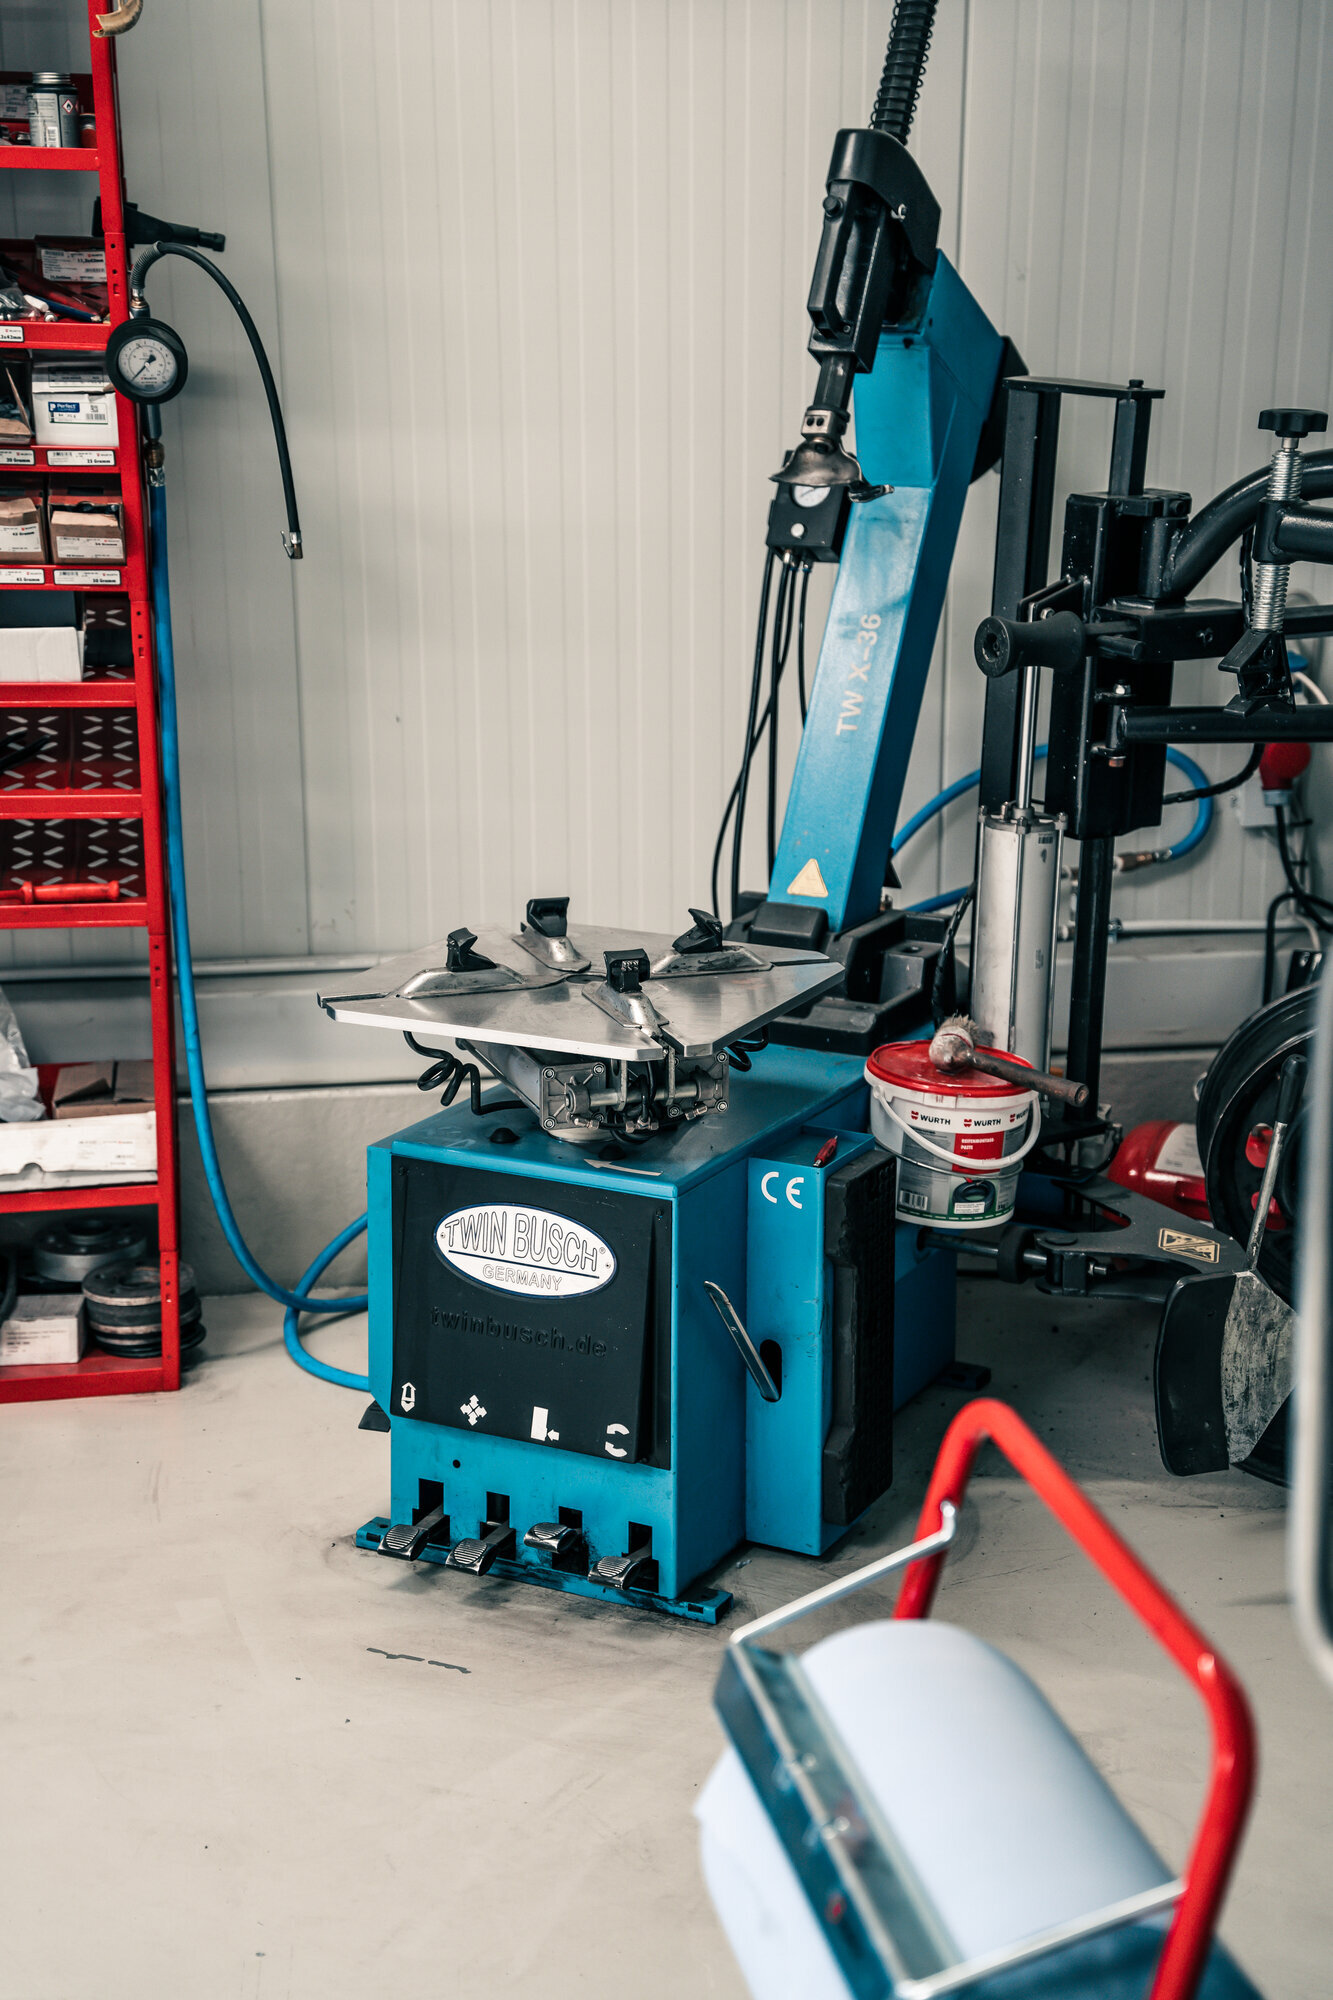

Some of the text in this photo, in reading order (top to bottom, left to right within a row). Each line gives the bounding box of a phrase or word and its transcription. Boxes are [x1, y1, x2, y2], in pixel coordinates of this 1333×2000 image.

[836, 614, 881, 736] TW X-36
[761, 1171, 805, 1210] CE
[445, 1211, 507, 1256] TWIN
[482, 1263, 563, 1291] GERMANY
[430, 1306, 608, 1358] twinbusch.de
